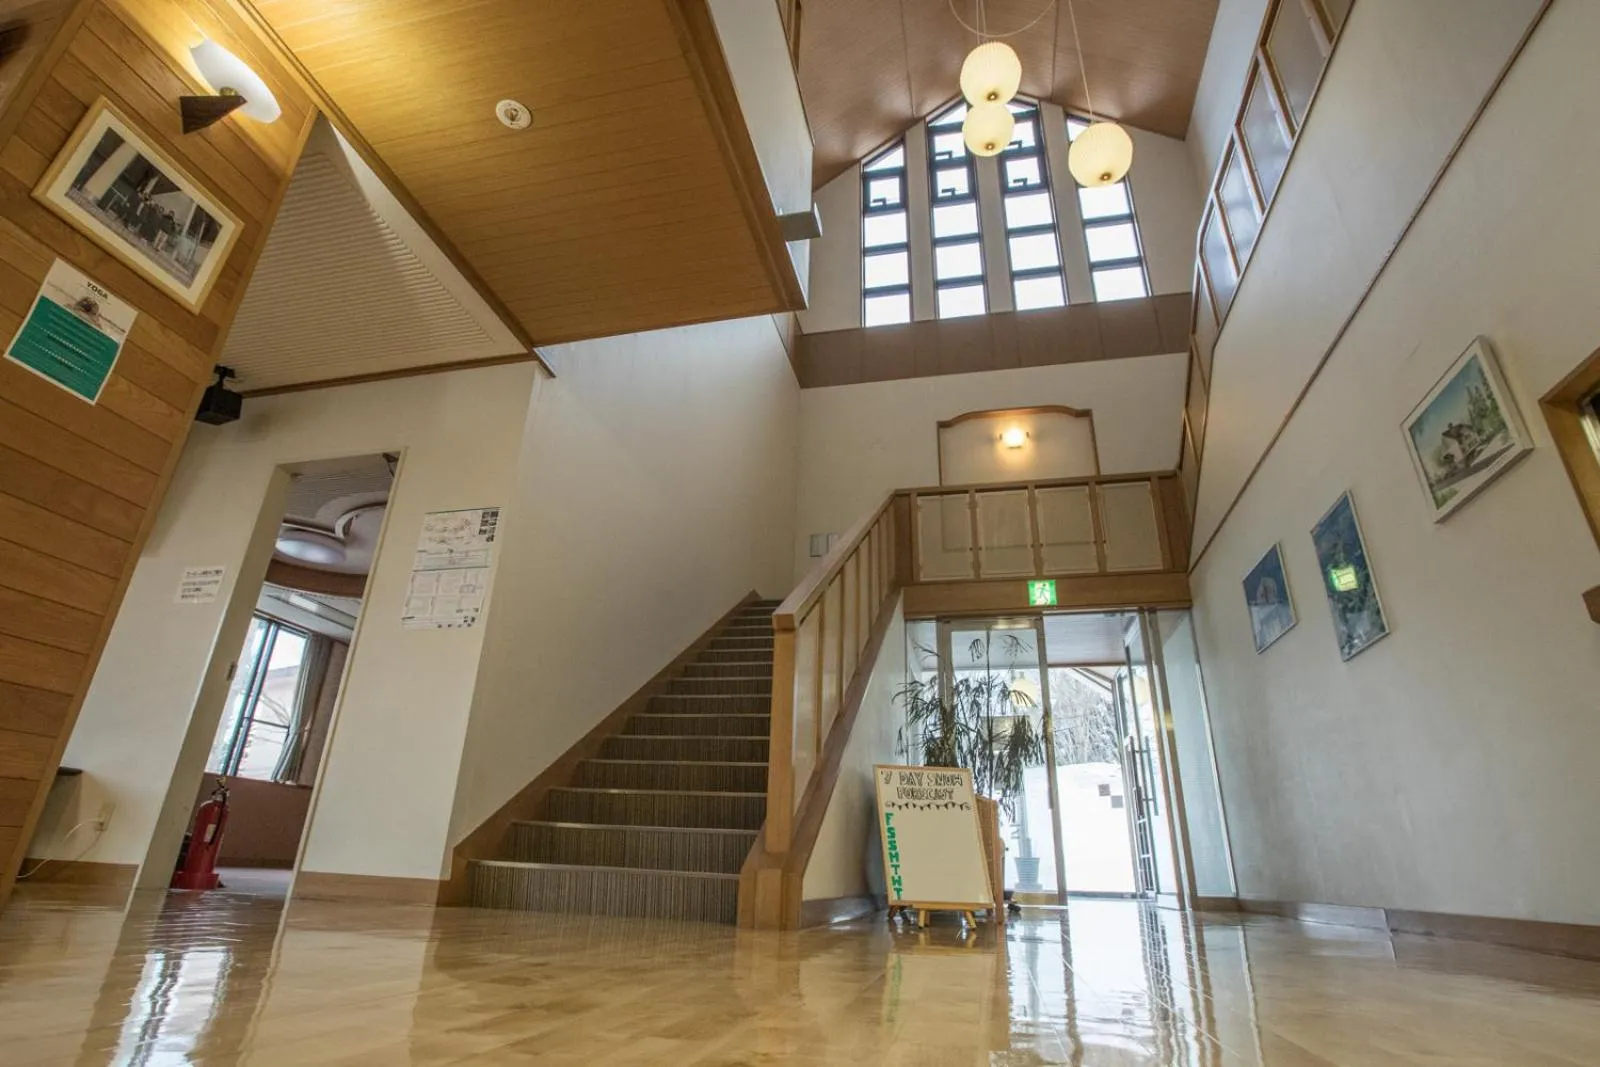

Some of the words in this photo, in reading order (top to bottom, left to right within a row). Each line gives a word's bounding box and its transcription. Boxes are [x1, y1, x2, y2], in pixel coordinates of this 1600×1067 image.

[88, 282, 108, 299] YOGA
[899, 771, 923, 786] DAY
[927, 772, 963, 787] SNOW
[897, 787, 954, 800] FORECAST
